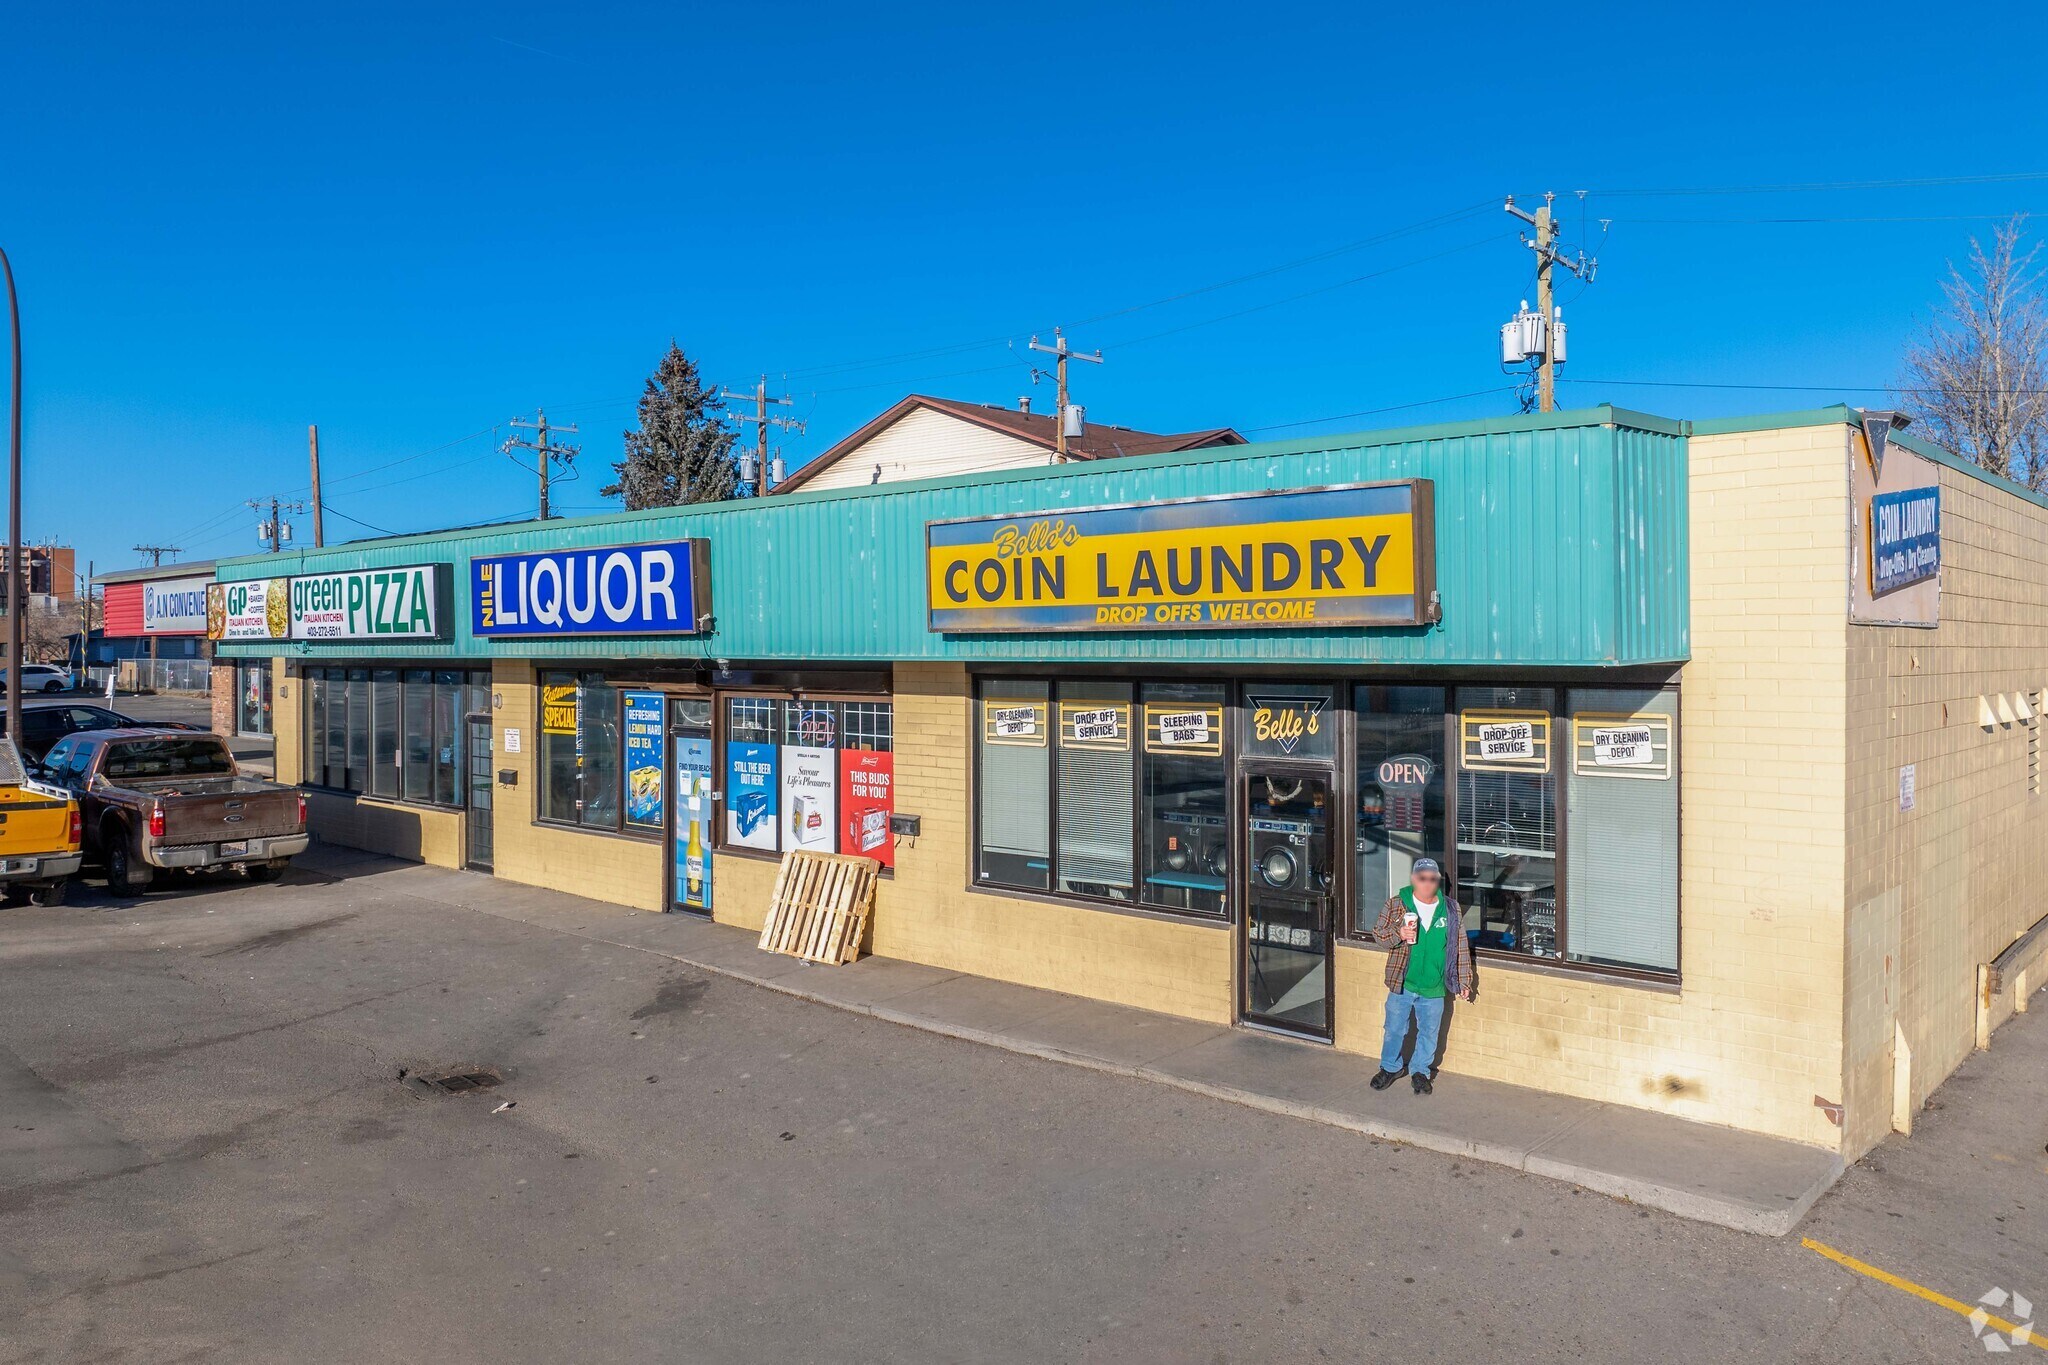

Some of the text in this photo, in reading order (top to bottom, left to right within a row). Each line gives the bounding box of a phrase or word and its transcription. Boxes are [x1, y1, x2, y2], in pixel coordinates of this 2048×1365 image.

[1880, 497, 1936, 546] COIN LAUNDRY
[993, 520, 1080, 559] Belle's
[1908, 548, 1917, 573] Dry
[1917, 542, 1936, 567] Cleaning
[945, 535, 1391, 602] COIN LAUNDRY
[481, 563, 494, 627] NILE
[495, 550, 677, 629] LIQUOR
[250, 595, 264, 603] BAKERY
[294, 577, 343, 621] green
[348, 571, 431, 634] PIZZA
[304, 613, 344, 623] ITALIAN KITCHEN
[1096, 601, 1316, 623] DROP OFFS WELCOME
[229, 617, 264, 626] ITALIAN KITCHEN
[307, 626, 341, 637] 403-272-5511
[629, 709, 660, 721] REFRESHING
[1075, 710, 1115, 725] DROP OFF
[1164, 715, 1203, 728] SLEEPING
[1008, 723, 1024, 733] DEPOT
[1254, 703, 1319, 741] Belle's
[629, 723, 661, 735] LEMON HARD
[801, 720, 834, 742] OPEN
[1079, 725, 1113, 738] SERVICE
[1173, 730, 1195, 741] BAGS
[1511, 728, 1528, 739] OFF
[629, 737, 652, 748] ICED TEA
[1613, 731, 1650, 744] CLEANING
[1488, 741, 1526, 753] SERVICE
[1611, 746, 1636, 758] DEPOT
[688, 763, 698, 771] YOUR
[734, 761, 771, 774] STILL THE BEER
[798, 766, 819, 776] Savour
[1380, 762, 1425, 784] OPEN
[741, 773, 764, 786] OUT HERE
[787, 775, 831, 788] Life's Pleasures
[850, 771, 889, 785] THIS BUDS
[852, 785, 887, 799] FOR YOU!
